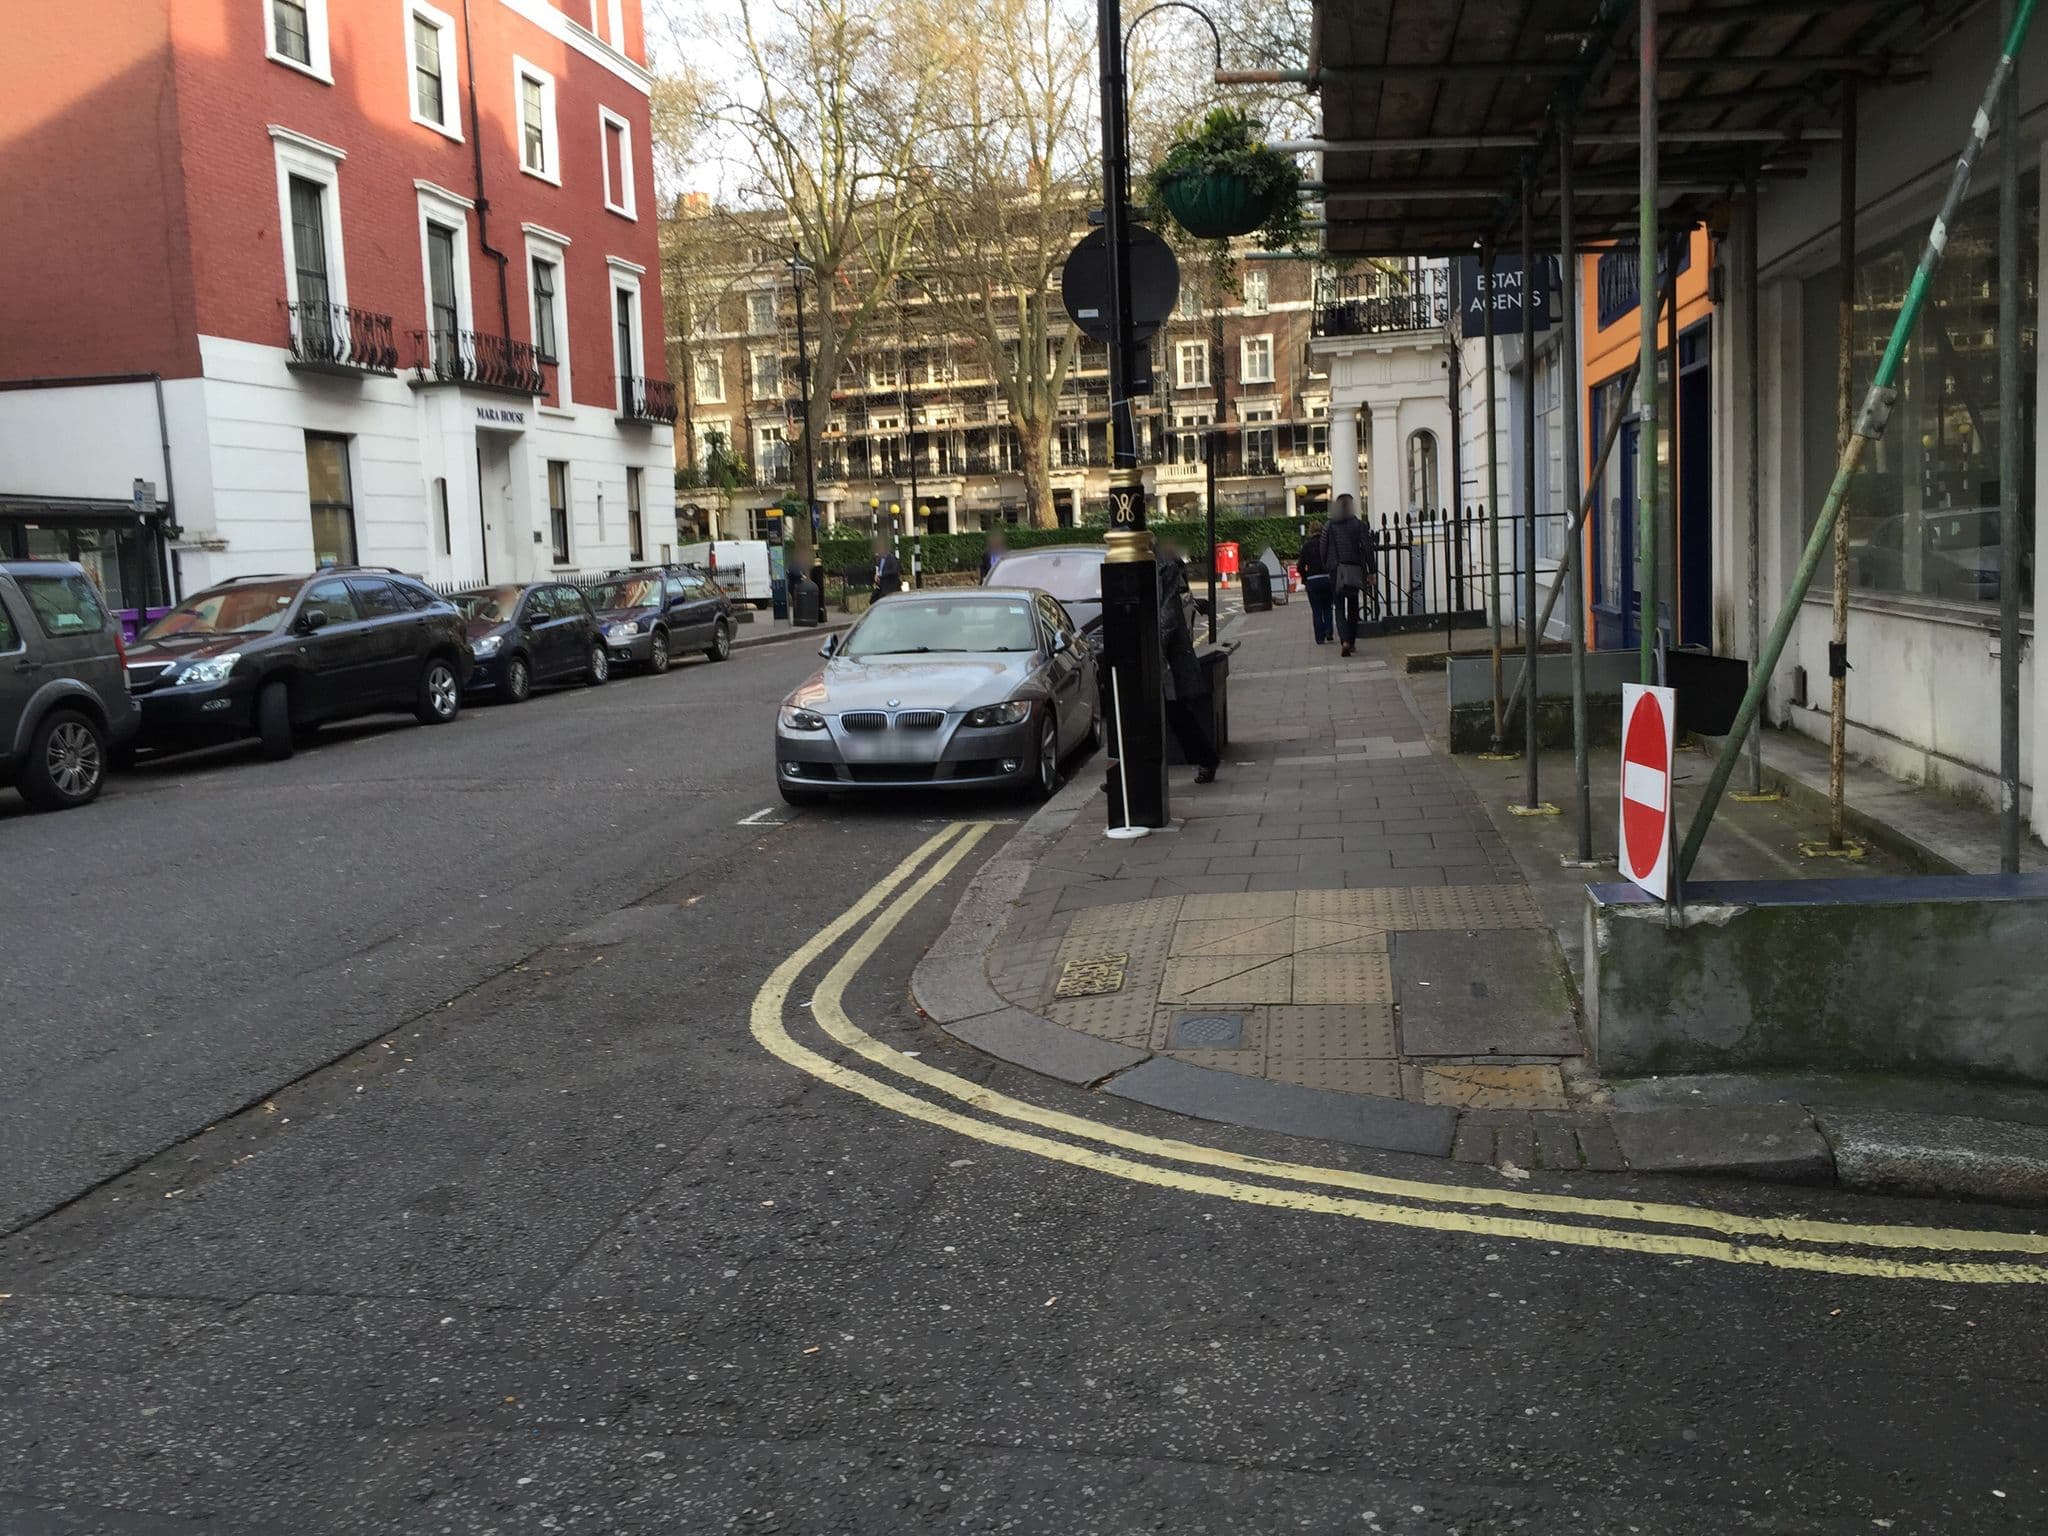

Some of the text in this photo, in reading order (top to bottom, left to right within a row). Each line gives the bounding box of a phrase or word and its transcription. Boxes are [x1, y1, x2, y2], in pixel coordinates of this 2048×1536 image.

[1477, 270, 1525, 290] ESTAT
[1470, 290, 1541, 312] AGENS
[476, 407, 524, 424] MARA HOUSE
